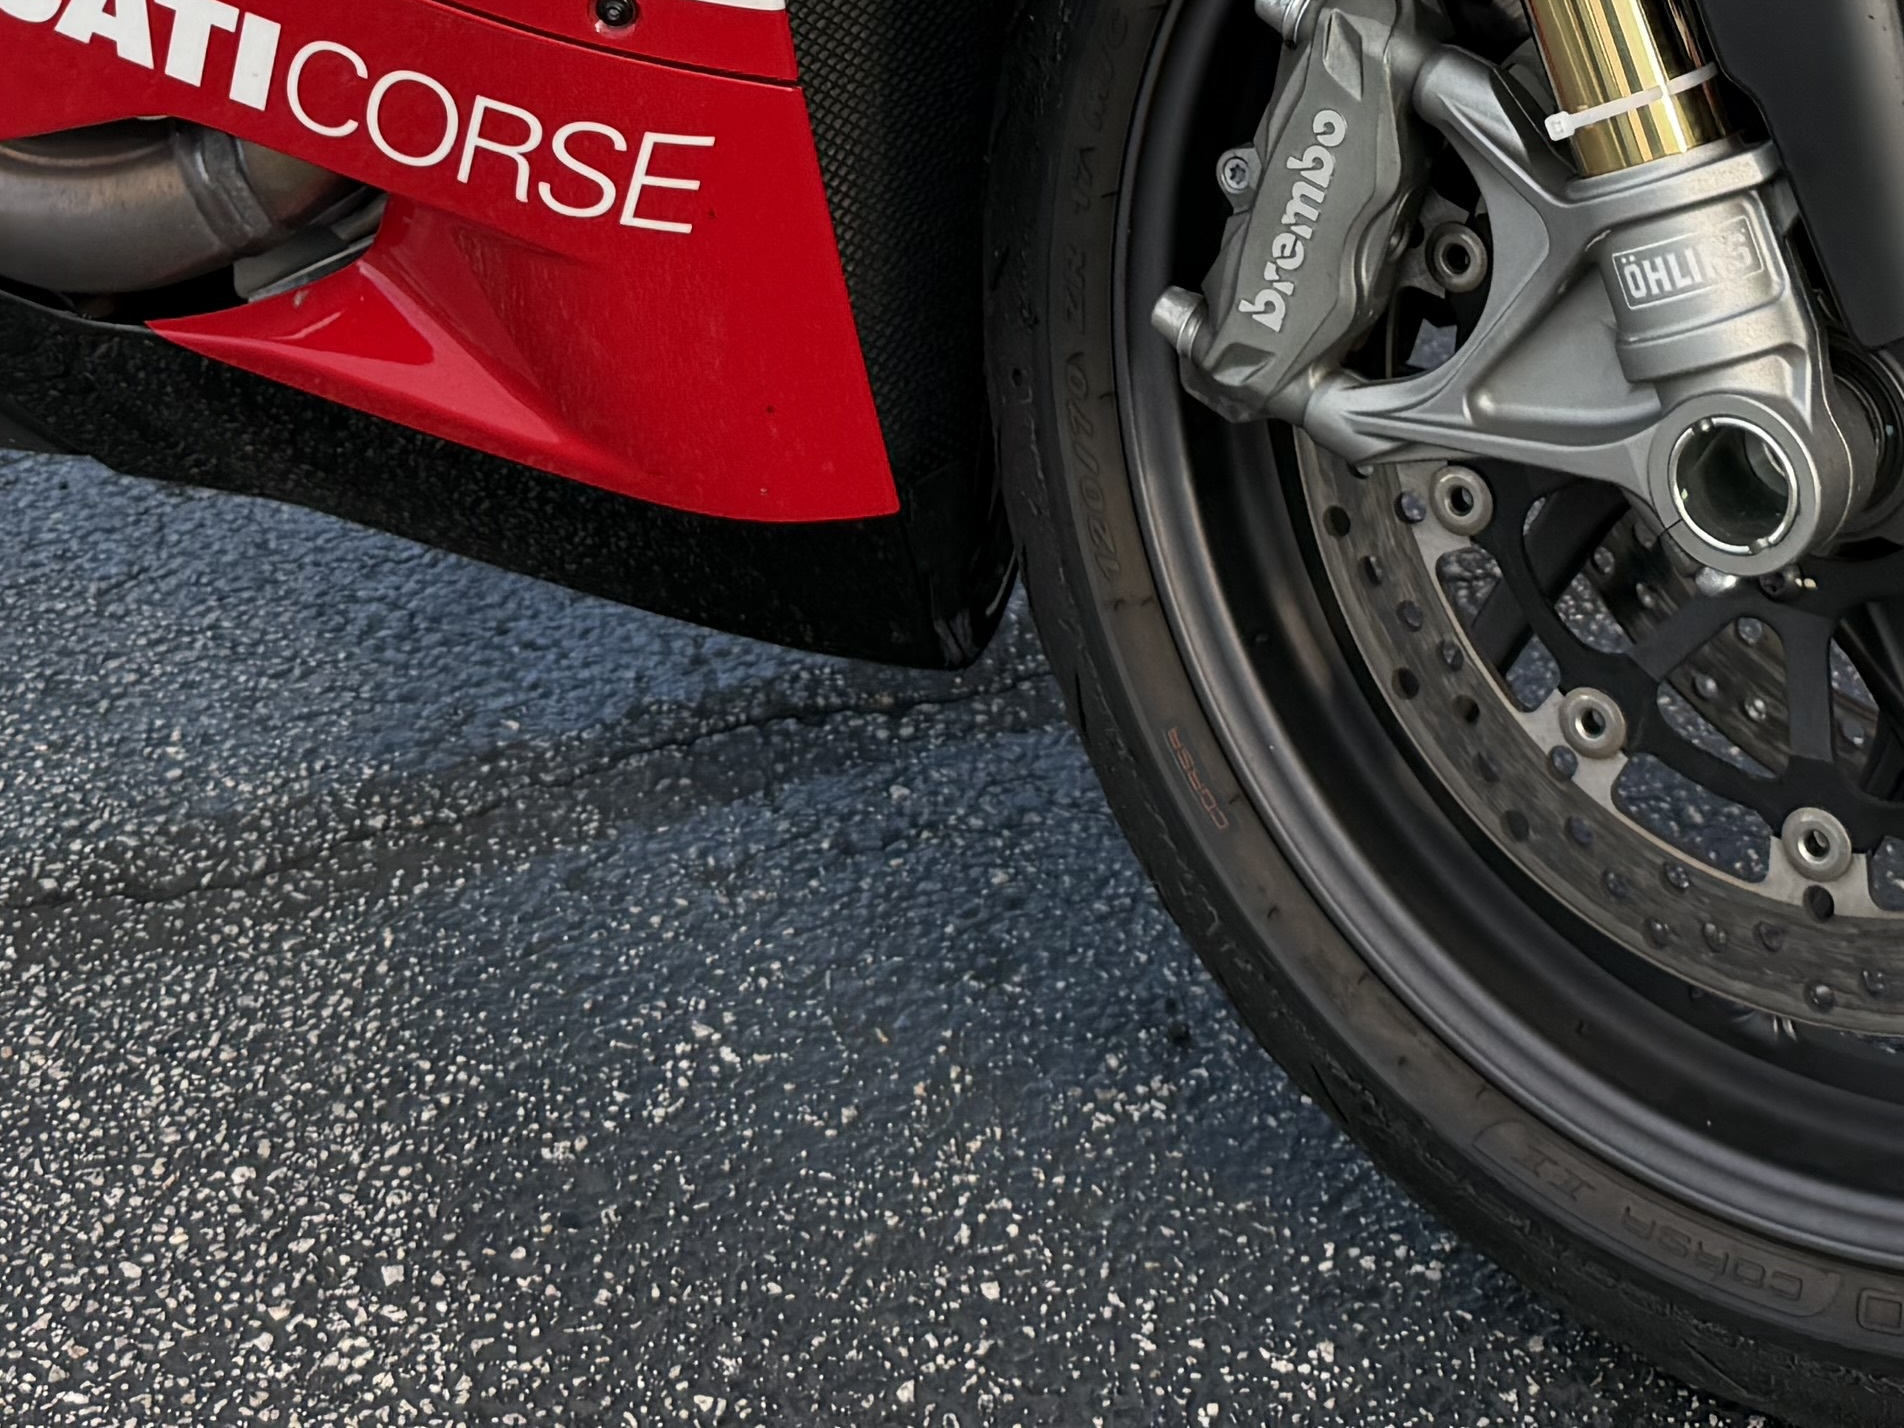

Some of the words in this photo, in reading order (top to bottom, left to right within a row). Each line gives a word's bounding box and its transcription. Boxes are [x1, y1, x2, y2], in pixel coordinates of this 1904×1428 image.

[285, 40, 716, 235] CORSE
[1236, 107, 1350, 334] brembo
[1619, 1204, 1804, 1302] CORSA
